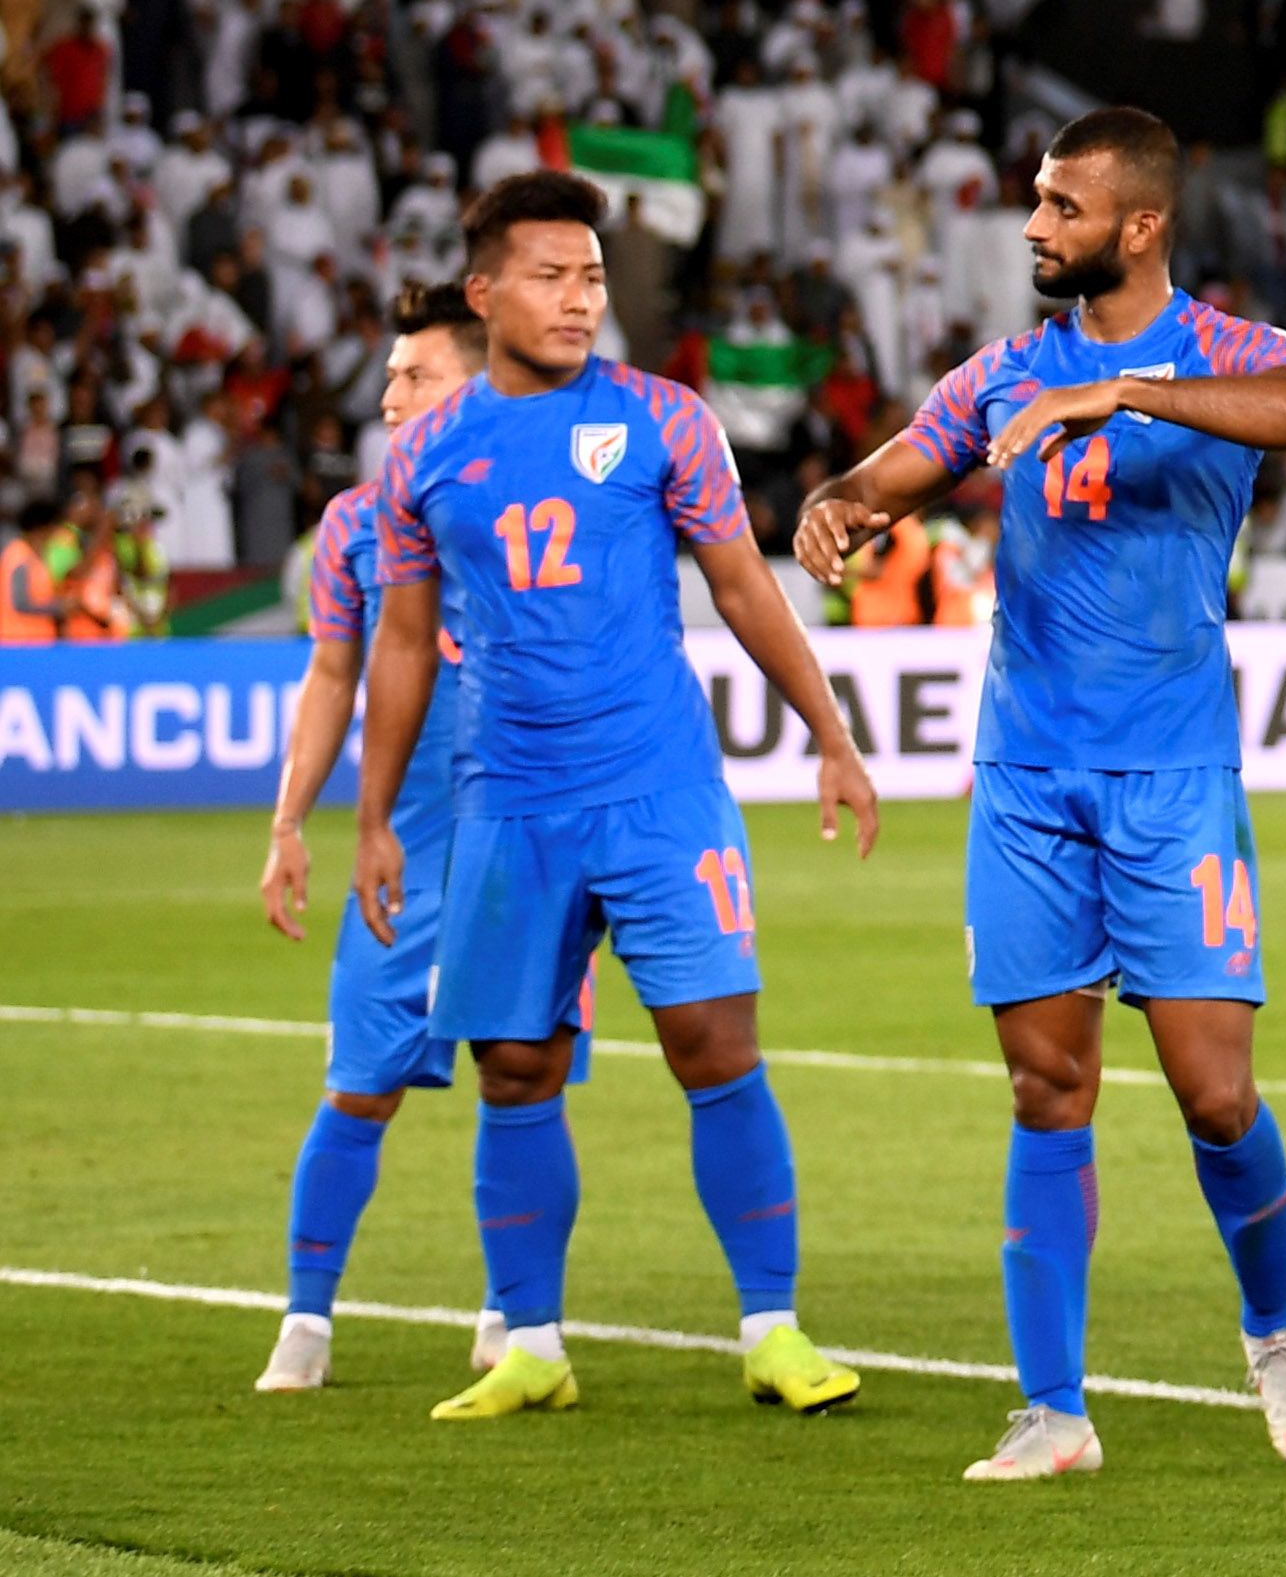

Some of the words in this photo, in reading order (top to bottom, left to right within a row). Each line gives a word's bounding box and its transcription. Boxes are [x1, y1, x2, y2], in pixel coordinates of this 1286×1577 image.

[1043, 434, 1113, 522] 14
[494, 497, 583, 592] 12
[710, 670, 962, 758] UAE
[1190, 852, 1257, 949] 14
